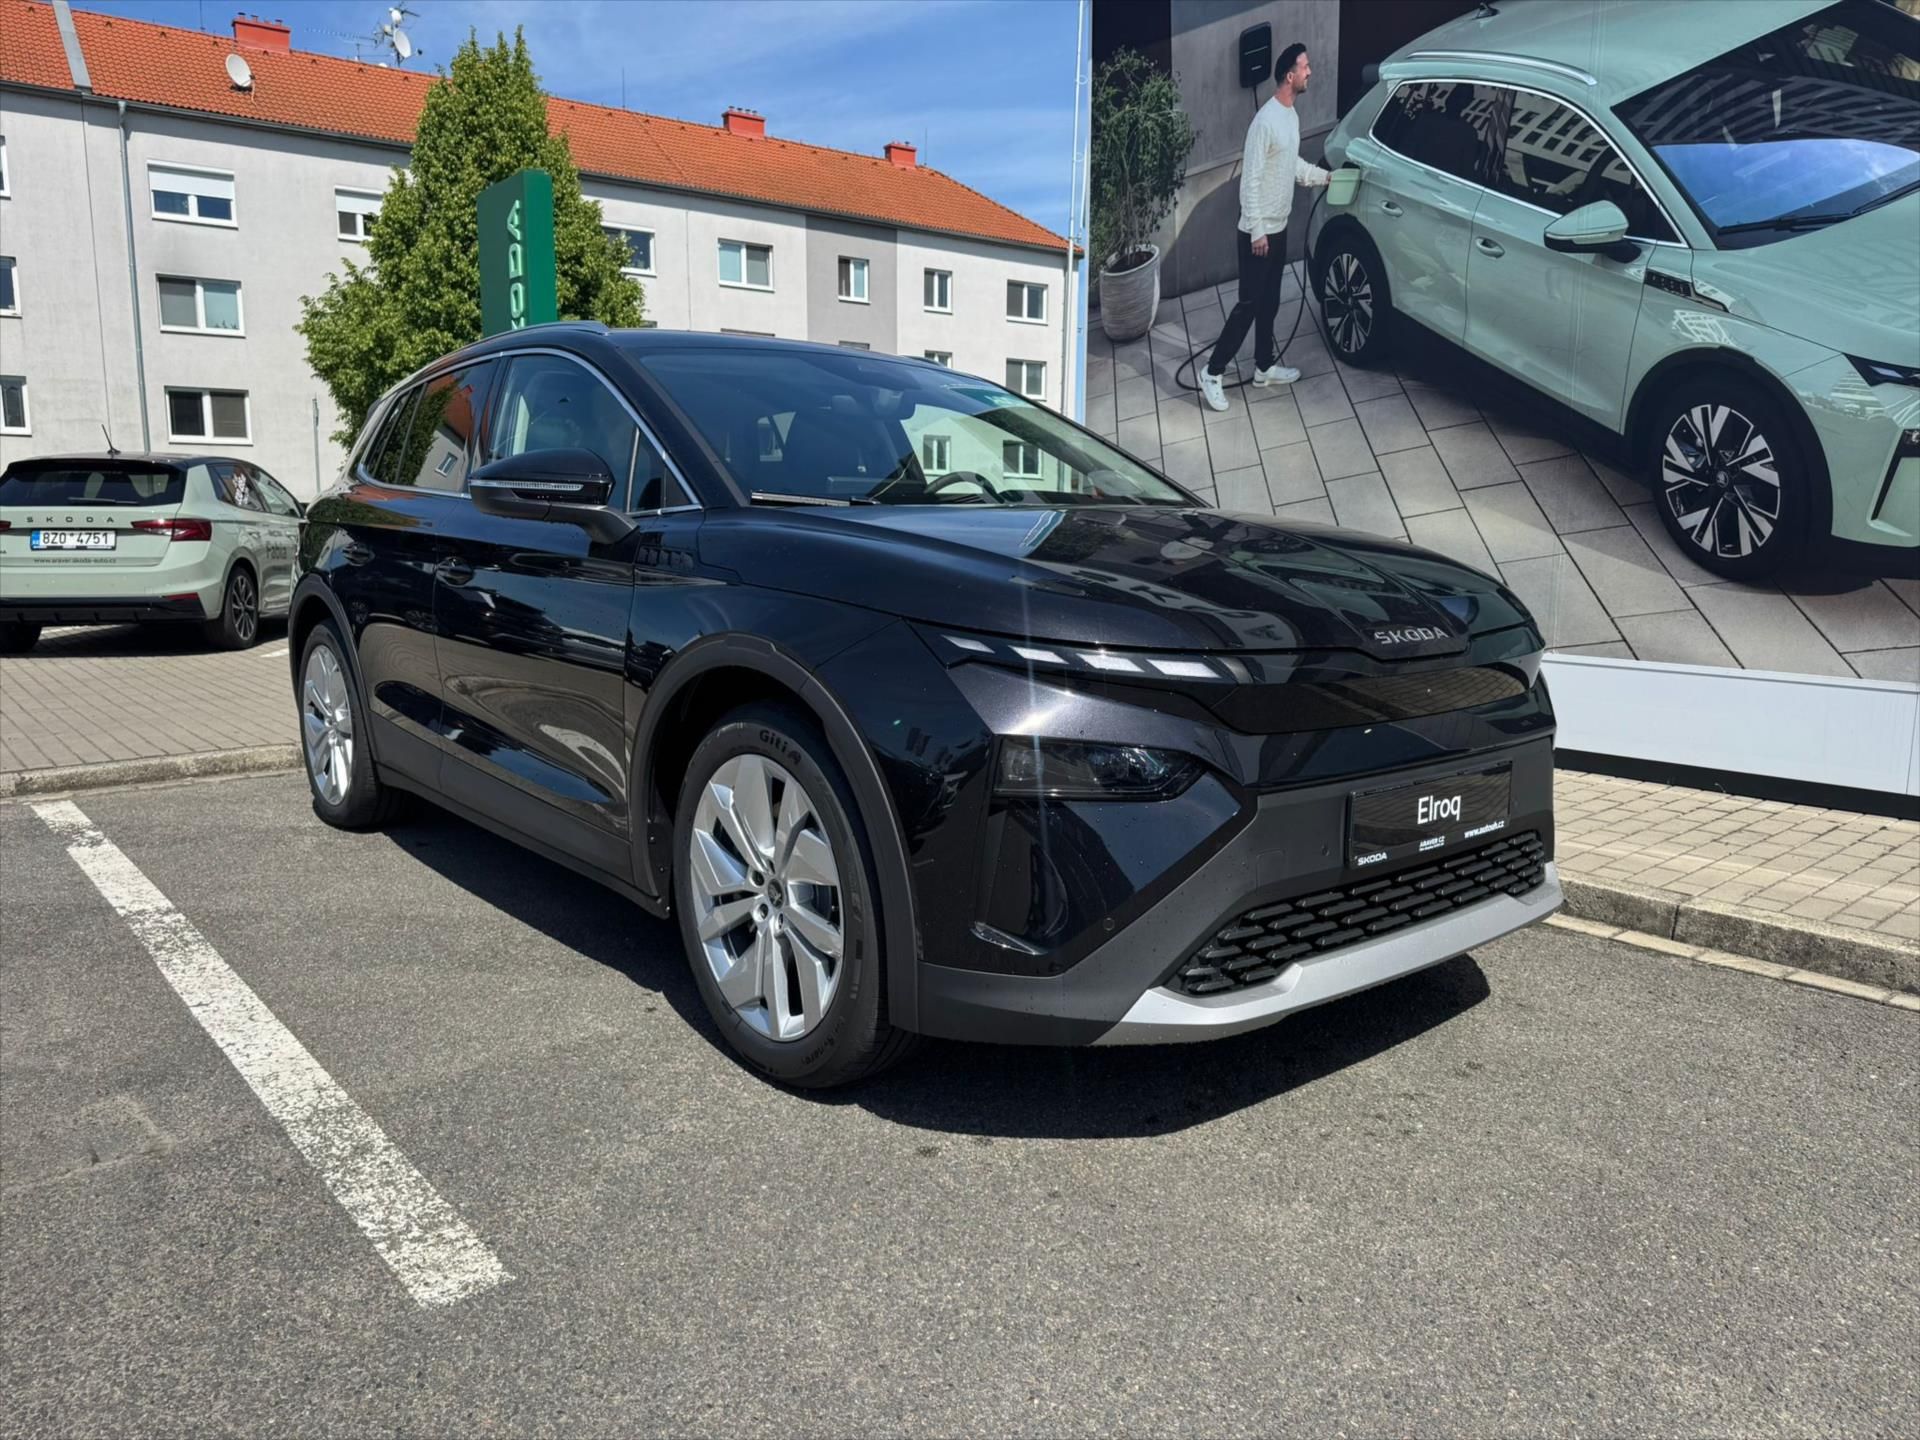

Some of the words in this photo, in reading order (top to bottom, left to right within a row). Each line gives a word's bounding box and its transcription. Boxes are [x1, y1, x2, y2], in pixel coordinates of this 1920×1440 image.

[77, 532, 108, 545] 4751
[1374, 626, 1449, 644] SKODA
[760, 730, 788, 753] Giti
[1417, 795, 1461, 824] Elroq
[1358, 852, 1387, 866] SKODA
